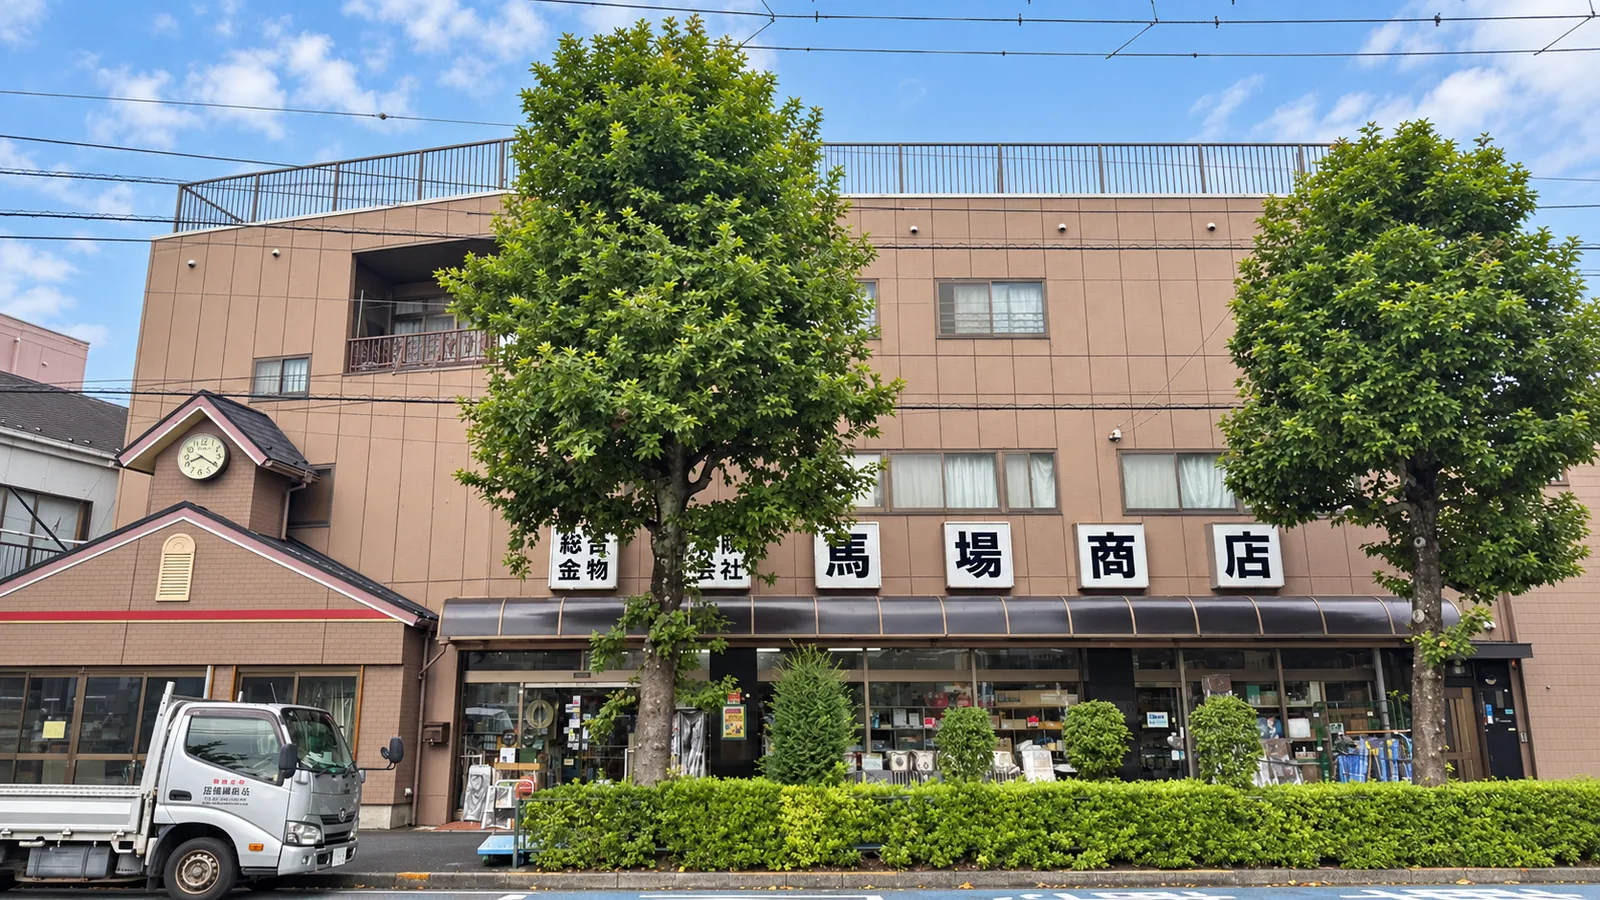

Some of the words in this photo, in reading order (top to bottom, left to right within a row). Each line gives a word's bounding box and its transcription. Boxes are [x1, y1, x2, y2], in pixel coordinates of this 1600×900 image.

[558, 558, 609, 581] 金物
[826, 531, 1272, 579] 馬場商店
